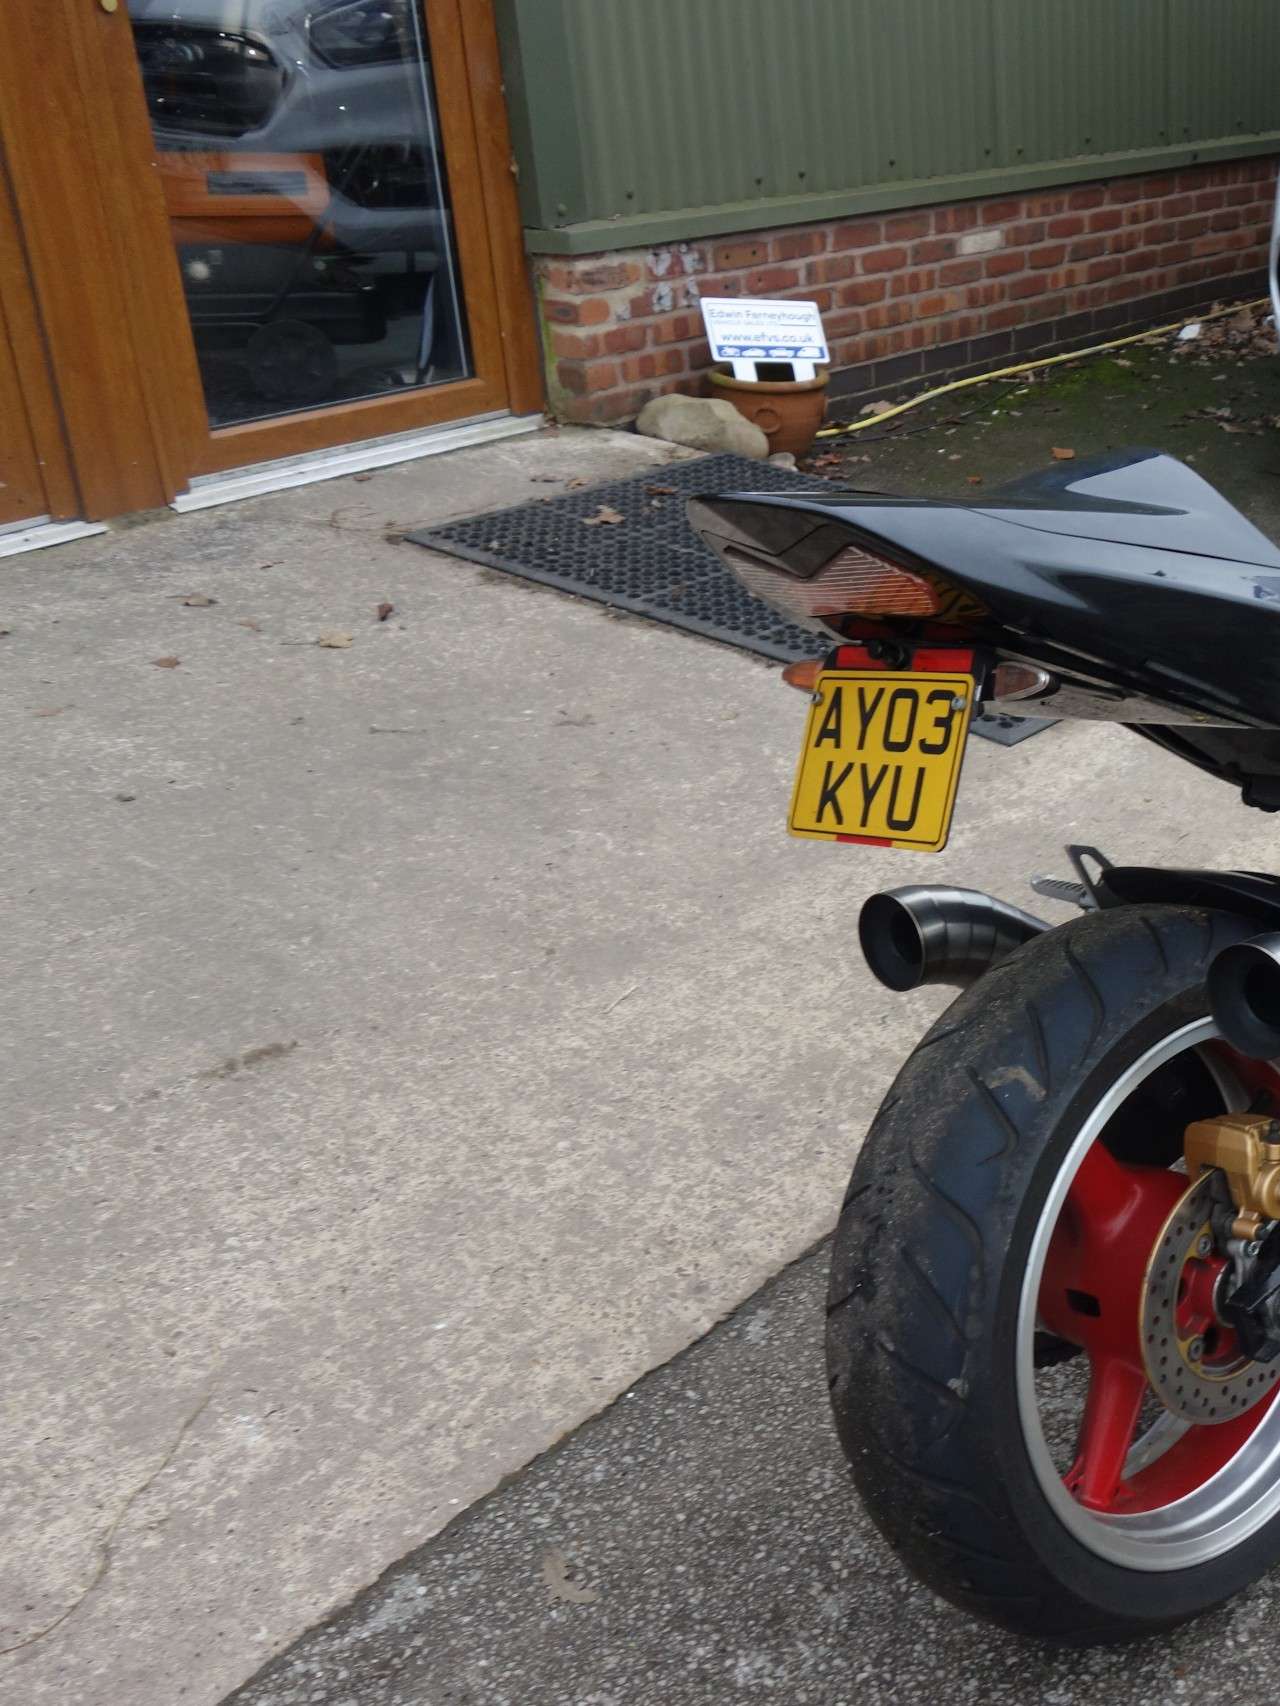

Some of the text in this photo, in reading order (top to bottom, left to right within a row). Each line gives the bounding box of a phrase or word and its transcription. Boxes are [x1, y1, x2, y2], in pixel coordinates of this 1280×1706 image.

[708, 308, 742, 319] Edwin
[814, 687, 957, 755] AY03
[815, 761, 926, 831] KYU
